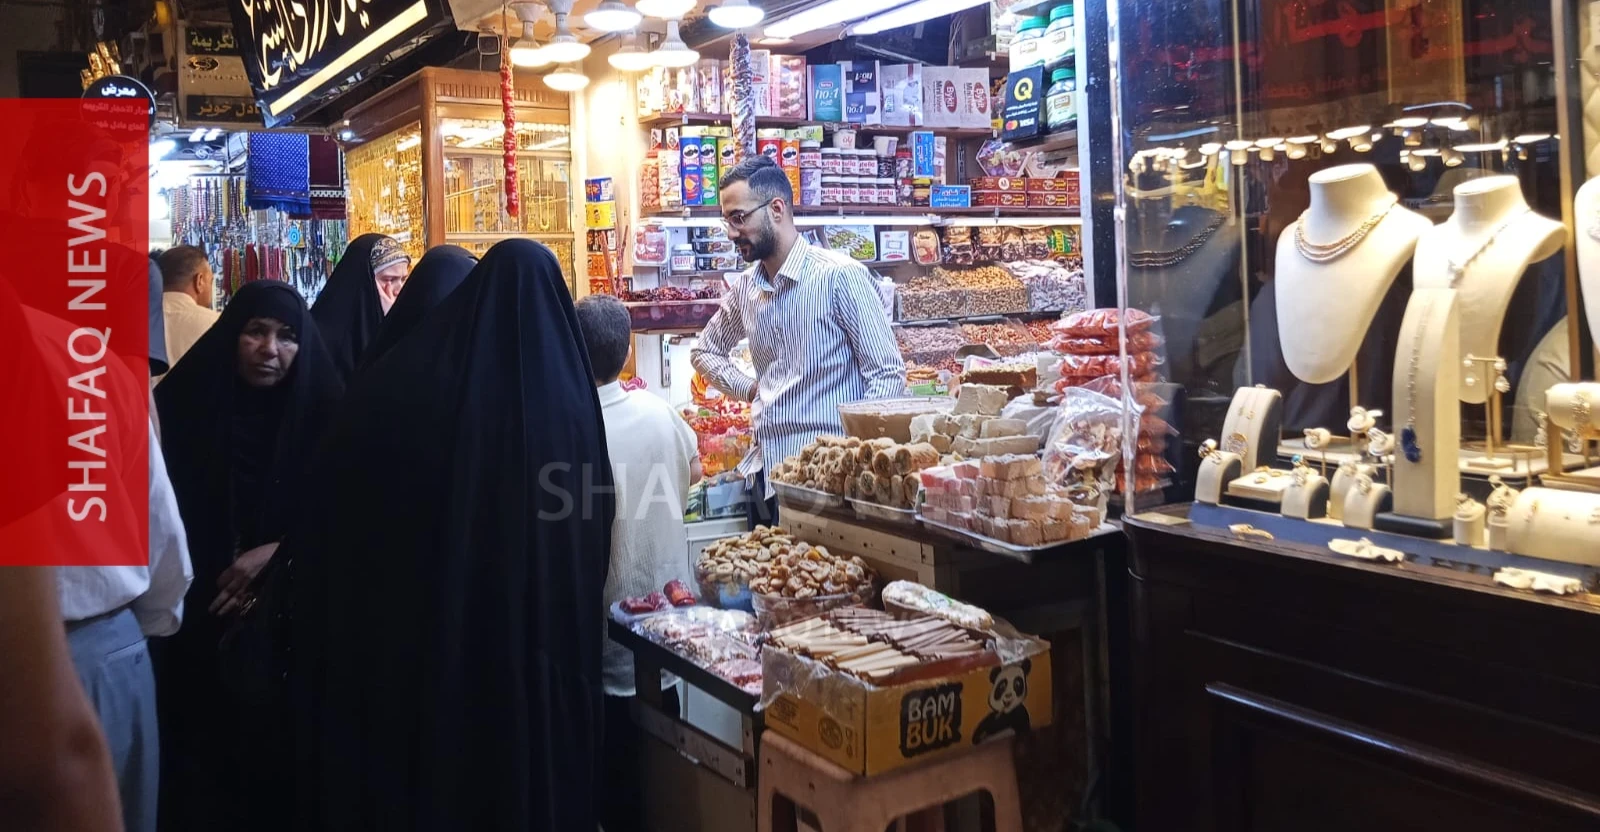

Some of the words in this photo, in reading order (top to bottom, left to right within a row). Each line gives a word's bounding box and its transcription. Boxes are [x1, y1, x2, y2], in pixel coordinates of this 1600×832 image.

[101, 83, 137, 97] معرض
[236, 102, 260, 117] ادل
[908, 690, 955, 722] BAM
[906, 714, 954, 749] BUK
